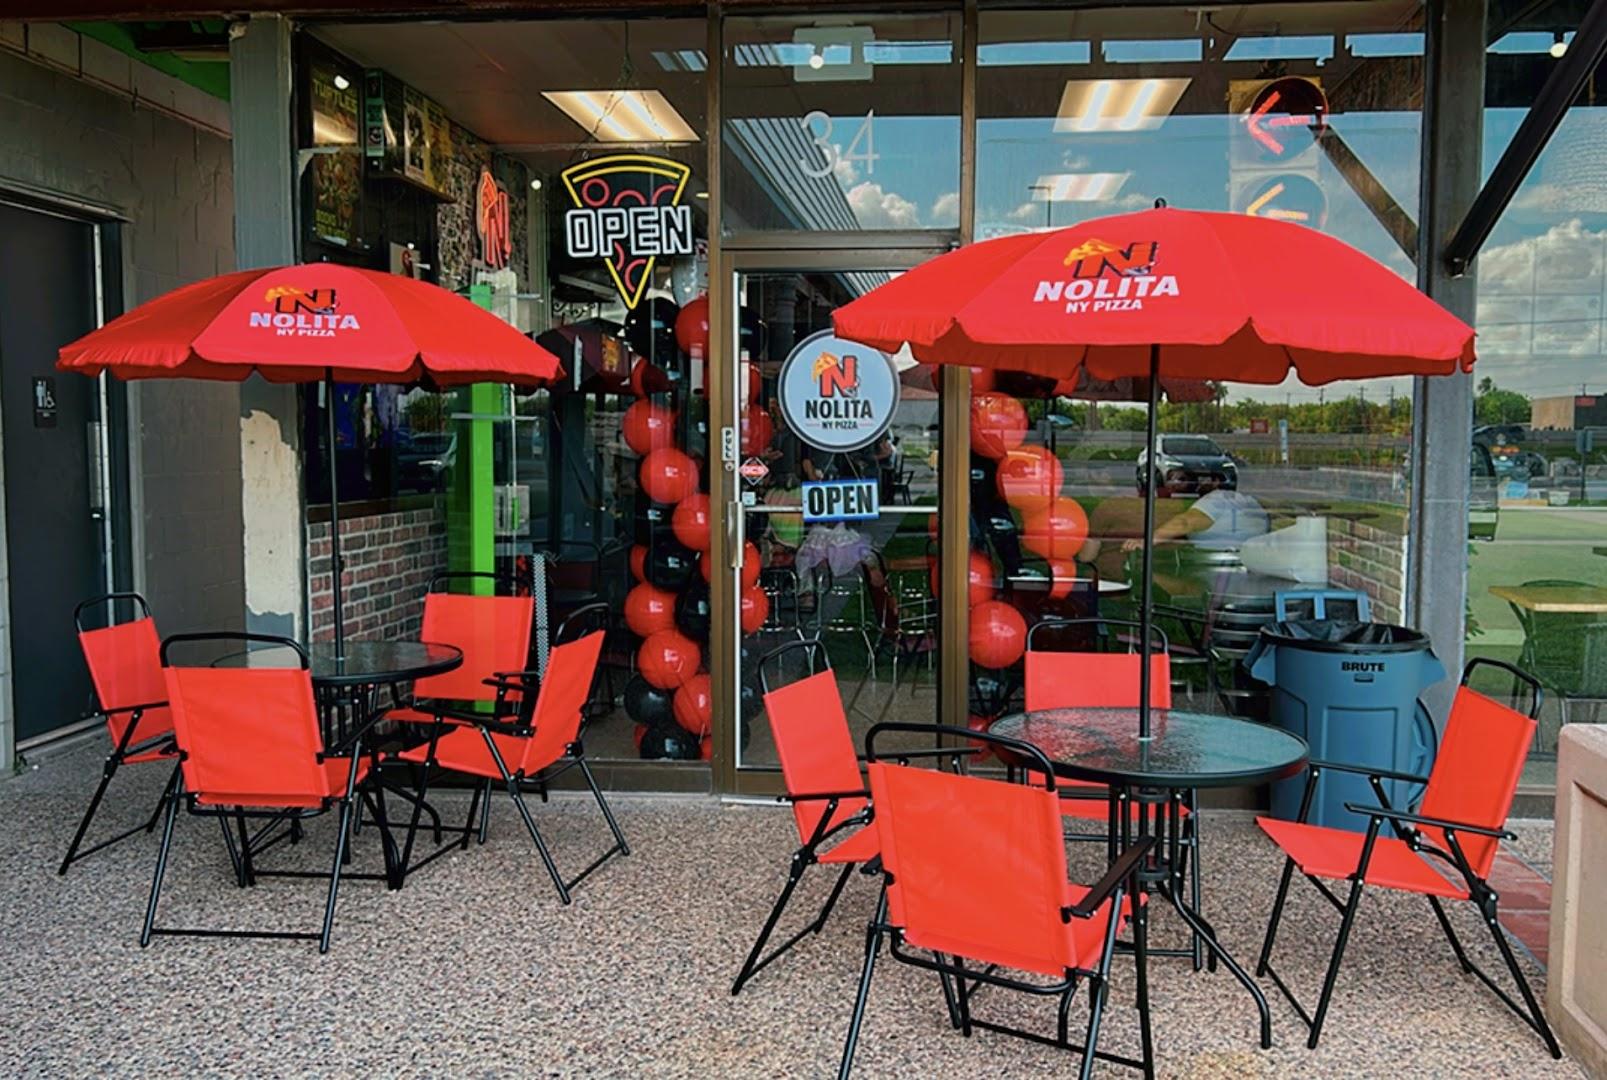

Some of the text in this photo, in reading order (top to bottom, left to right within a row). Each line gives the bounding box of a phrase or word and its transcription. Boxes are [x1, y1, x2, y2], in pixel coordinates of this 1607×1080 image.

[800, 108, 880, 178] 34
[566, 205, 693, 258] OPEN
[1033, 275, 1180, 302] NOLITA
[1066, 299, 1142, 313] NY PIZZA
[249, 312, 360, 329] NOLITA
[276, 328, 336, 337] NY PIZZA
[805, 400, 873, 419] NOLITA
[822, 420, 858, 430] NY PIZZA
[724, 430, 732, 459] PULL
[808, 485, 873, 516] OPEN
[1341, 661, 1385, 672] BRUTE
